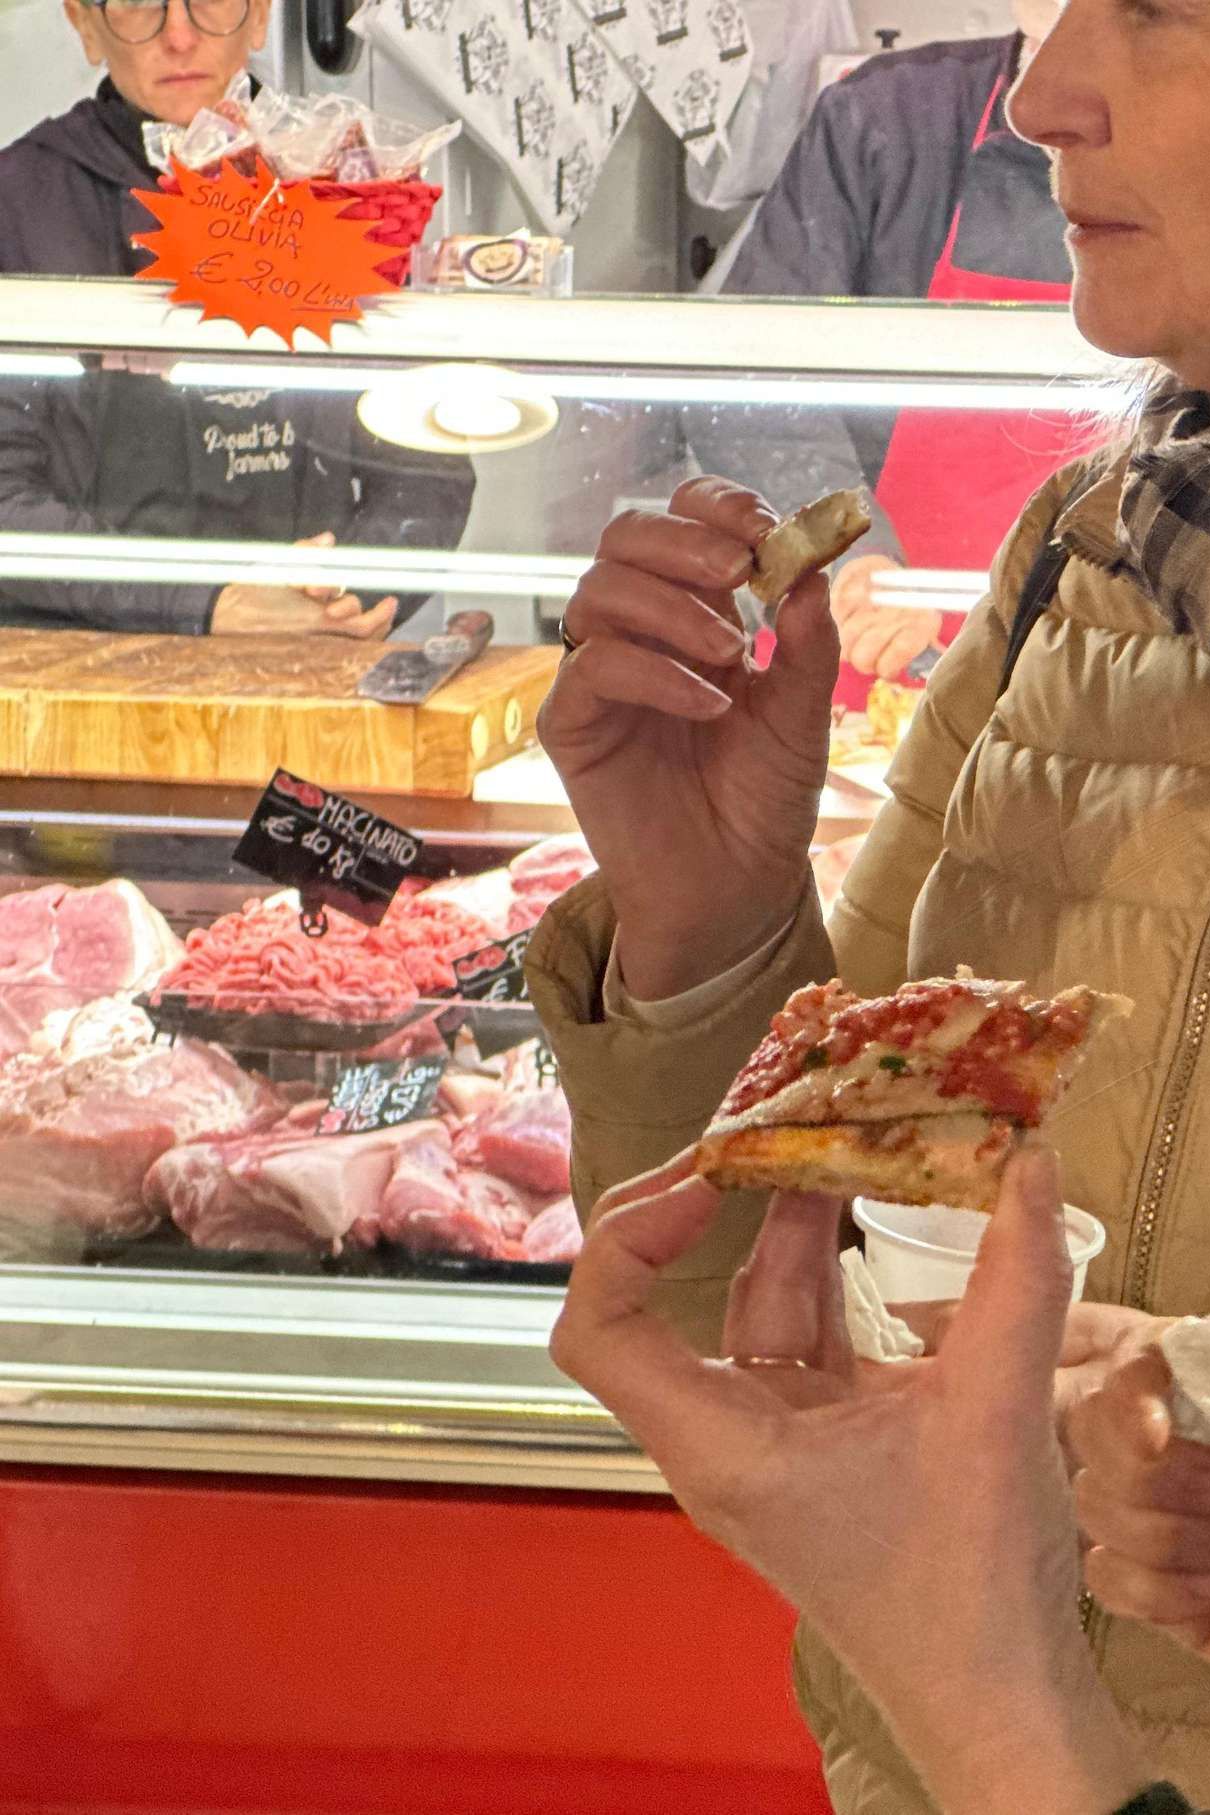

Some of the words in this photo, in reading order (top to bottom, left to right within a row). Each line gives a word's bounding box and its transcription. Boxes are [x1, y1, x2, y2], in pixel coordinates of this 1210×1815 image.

[189, 251, 235, 284] €
[260, 815, 298, 844] €
[318, 797, 418, 867] MACINATO
